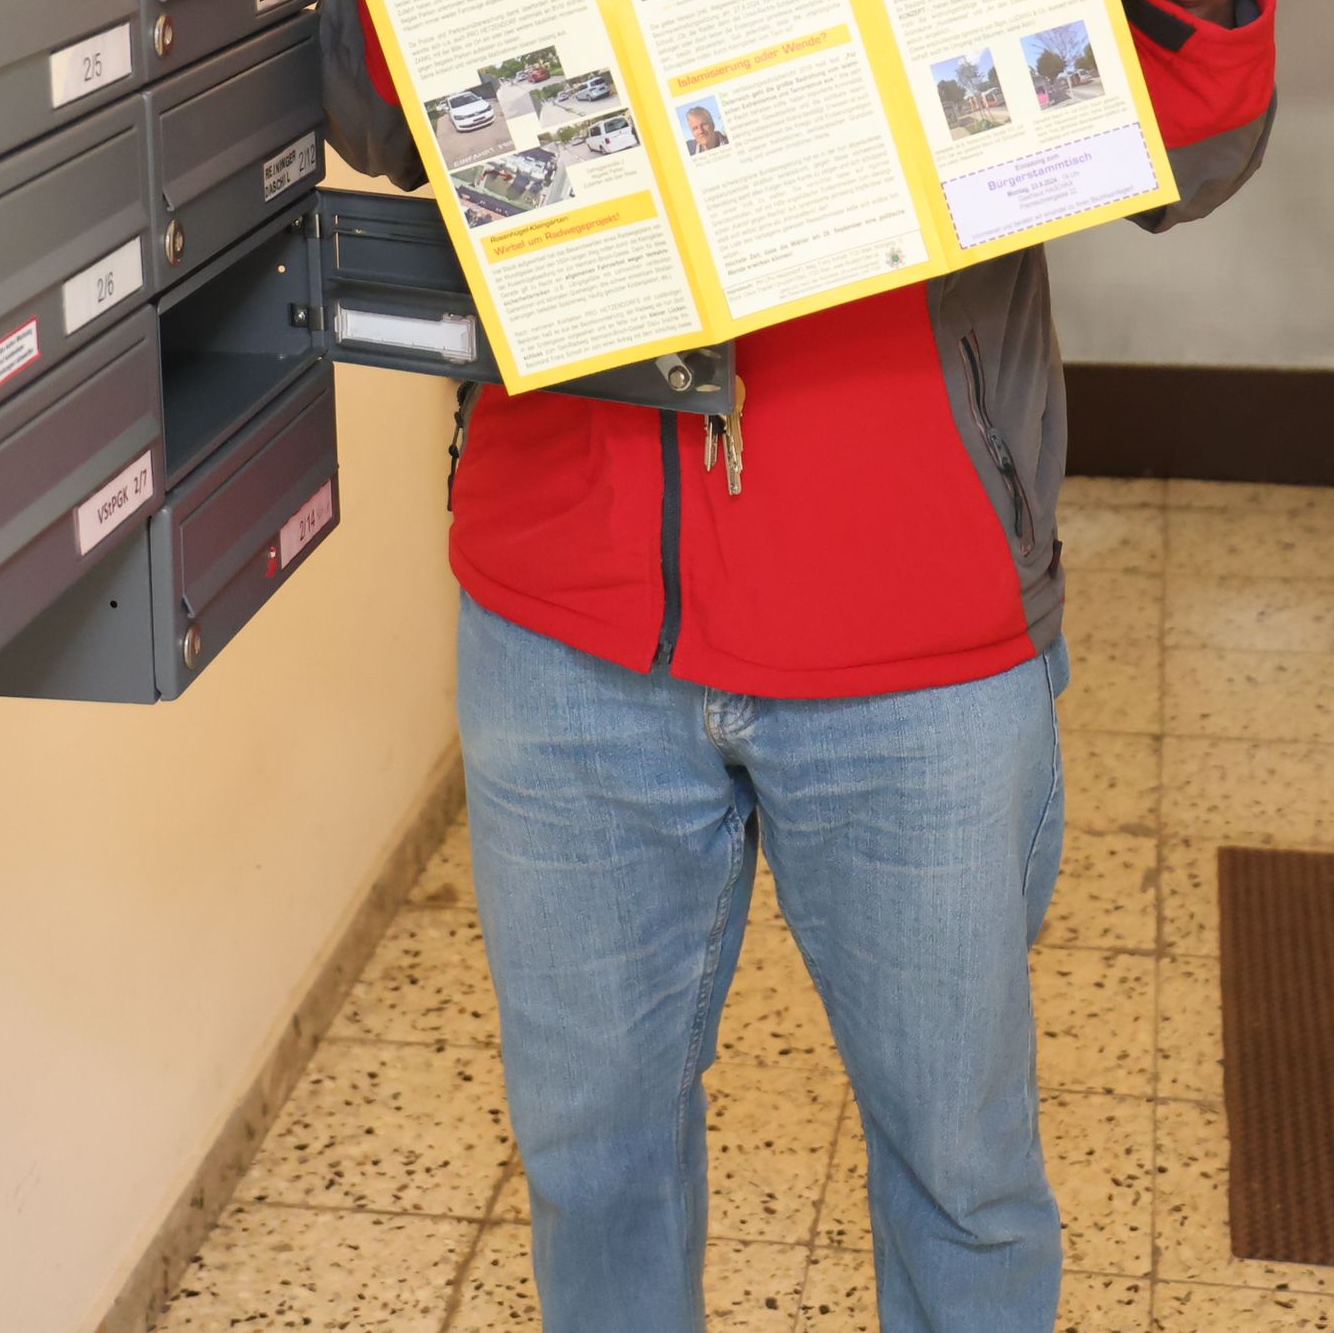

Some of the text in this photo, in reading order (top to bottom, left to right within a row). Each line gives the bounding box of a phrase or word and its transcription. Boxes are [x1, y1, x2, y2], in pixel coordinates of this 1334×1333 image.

[83, 52, 103, 83] 2/5
[677, 32, 828, 88] Islamisierung oder Wende?
[298, 144, 316, 173] 2/12
[494, 212, 621, 257] Wirbel um Radwegeprojekt!
[97, 271, 115, 303] 2/6
[97, 468, 148, 524] VStPGK 2/7
[299, 507, 316, 542] 2/14
